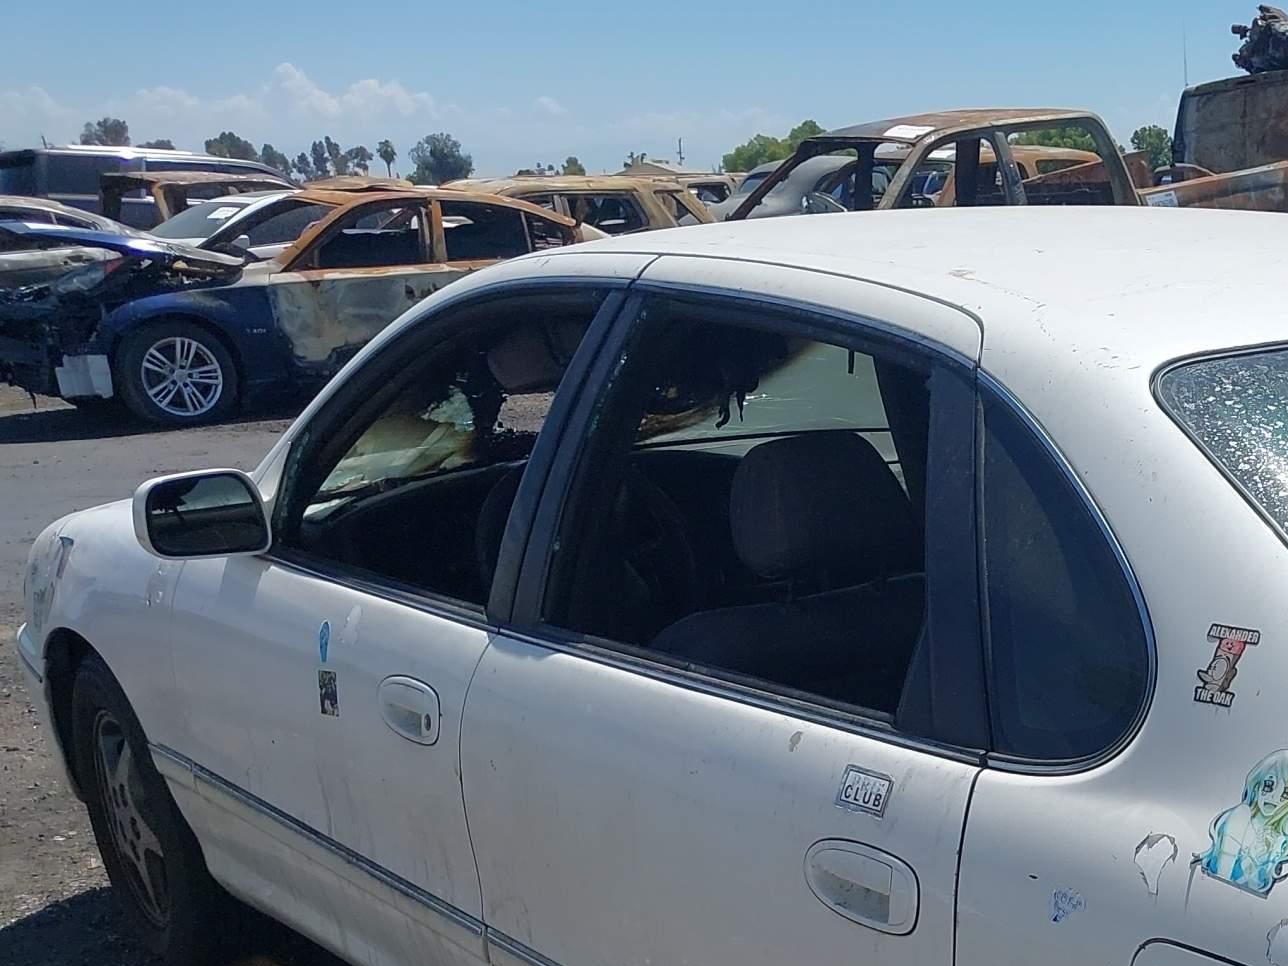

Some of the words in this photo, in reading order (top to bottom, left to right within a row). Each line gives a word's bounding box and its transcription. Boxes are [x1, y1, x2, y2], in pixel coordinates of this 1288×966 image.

[1209, 625, 1260, 644] ALEXANDER
[1195, 688, 1212, 702] THE
[1213, 691, 1234, 706] OAK
[844, 784, 883, 808] CLUB
